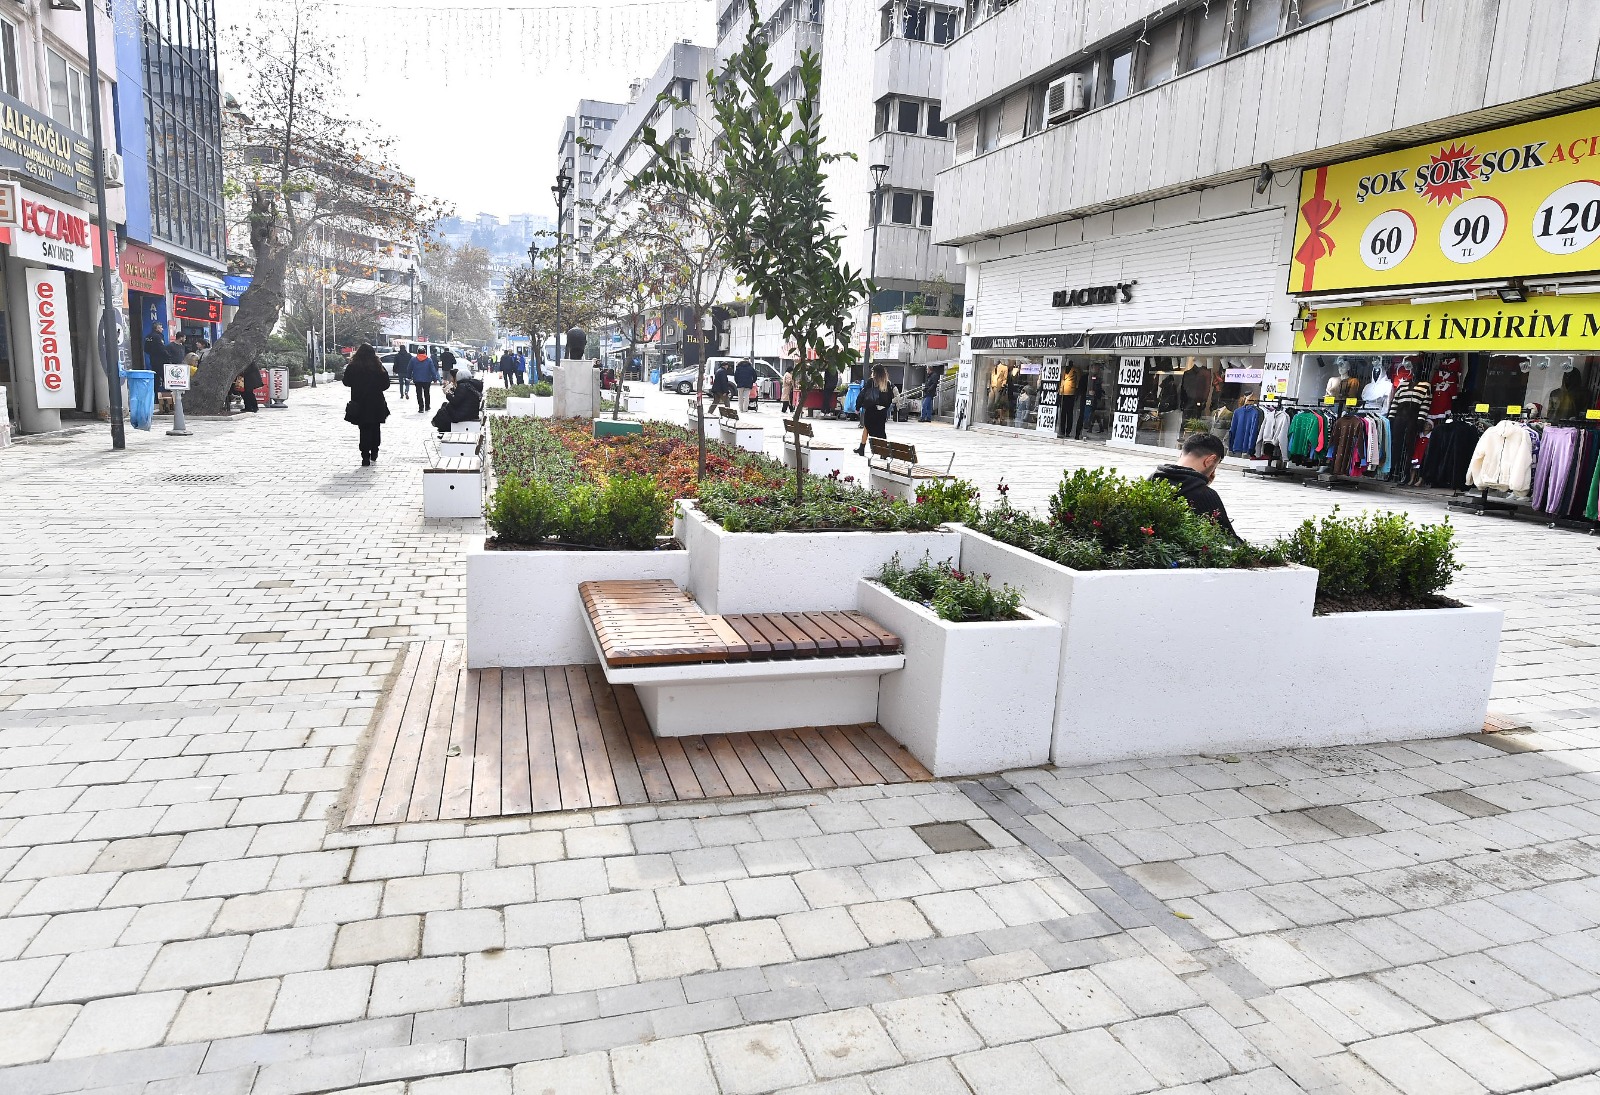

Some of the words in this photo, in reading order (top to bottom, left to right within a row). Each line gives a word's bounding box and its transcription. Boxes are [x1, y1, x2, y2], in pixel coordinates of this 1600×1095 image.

[1357, 169, 1408, 203] ŞOK
[1414, 156, 1473, 194] ŞOK
[1480, 141, 1547, 182] ŞOK
[1548, 136, 1600, 165] AÇI
[21, 197, 90, 249] ECZANE
[1537, 200, 1600, 237] 120
[1452, 214, 1490, 247] 90
[1370, 226, 1402, 256] 60
[1562, 237, 1577, 247] TL
[42, 241, 75, 263] SAYINER
[1461, 248, 1474, 257] TL
[1377, 257, 1388, 265] TL
[1052, 283, 1133, 308] BLACKER'S
[1323, 312, 1432, 342] SÜREKLİ
[1438, 308, 1573, 339] İNDİRİM
[37, 282, 62, 390] eczane
[1027, 337, 1057, 348] CLASSICS
[1169, 332, 1217, 346] CLASSICS
[1043, 366, 1060, 380] 1.999
[1120, 368, 1142, 384] 1.999
[1042, 383, 1057, 391] KABAN
[1120, 387, 1138, 395] KABAN
[1040, 391, 1057, 404] 1.499
[1117, 396, 1139, 412] 1.499
[1038, 415, 1055, 428] 1.299
[1118, 414, 1133, 423] CEKET
[1114, 424, 1134, 439] 1.299
